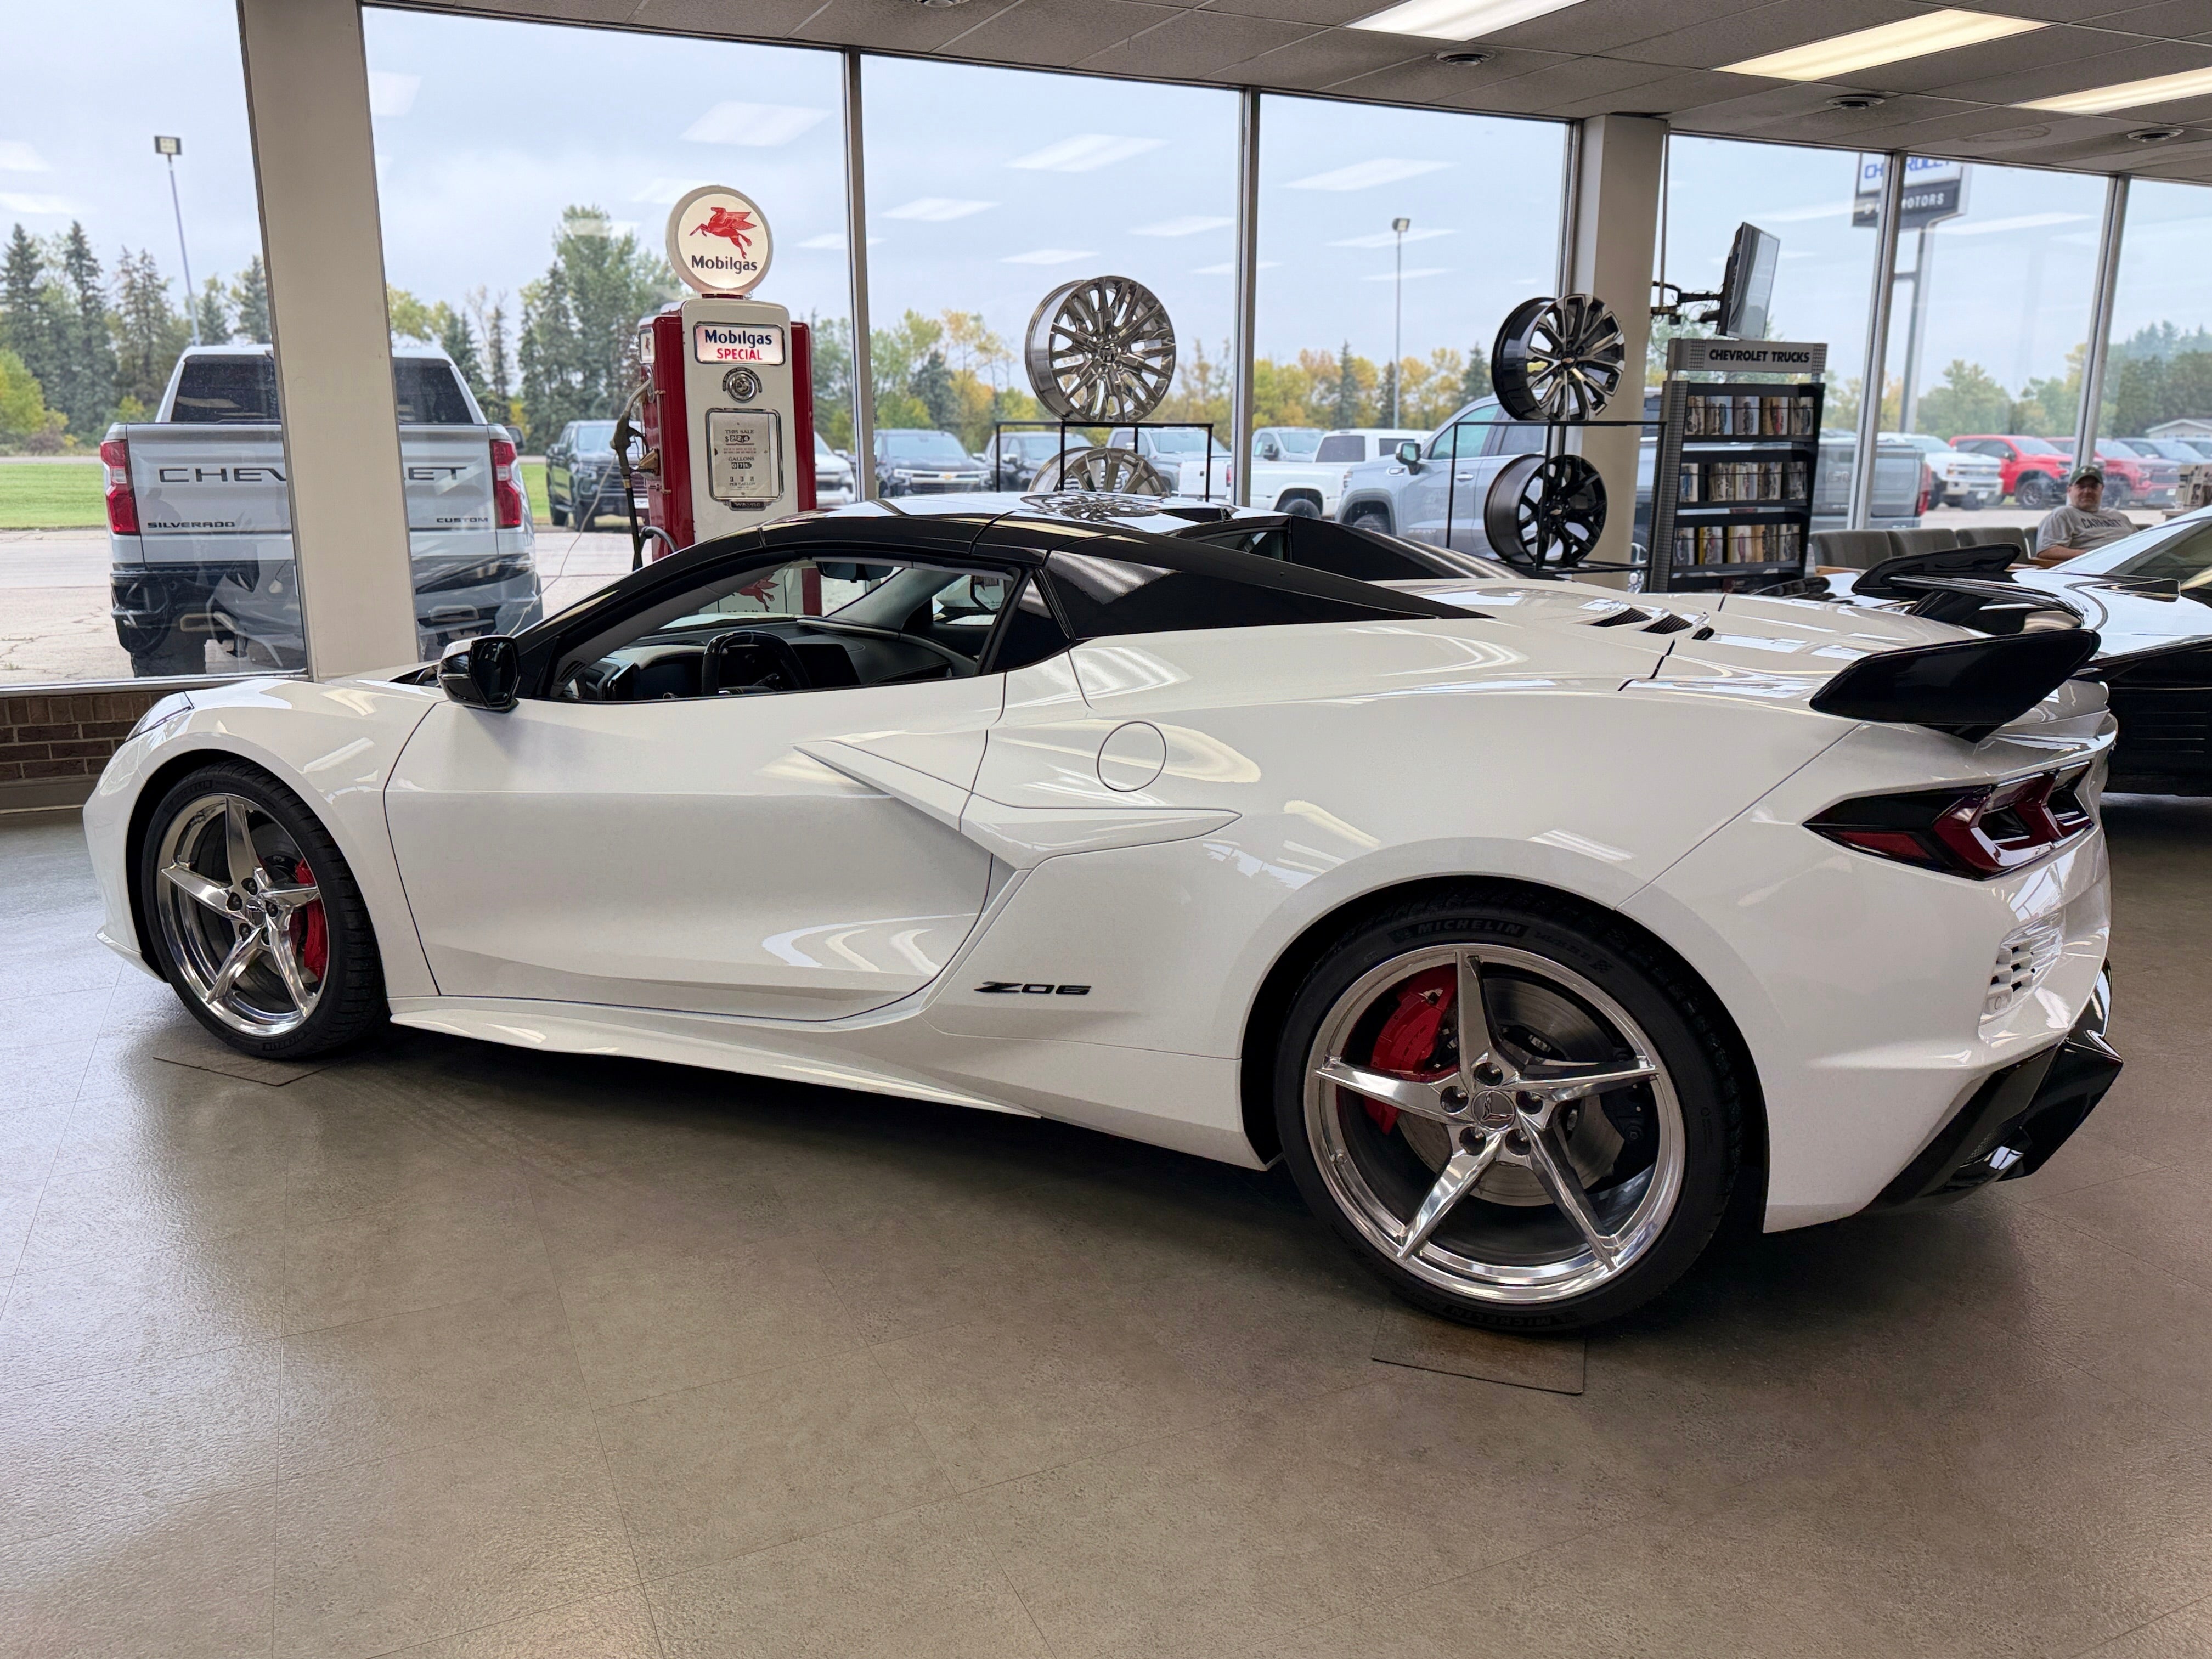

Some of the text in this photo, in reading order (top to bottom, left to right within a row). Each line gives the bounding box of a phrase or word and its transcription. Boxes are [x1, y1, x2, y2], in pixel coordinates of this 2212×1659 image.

[691, 255, 758, 274] Mobilgas
[704, 329, 772, 348] Mobilgas
[716, 348, 763, 360] SPECIAL
[1709, 349, 1810, 363] CHEVROLET TRUCKS
[1418, 919, 1523, 935] MICHELIN
